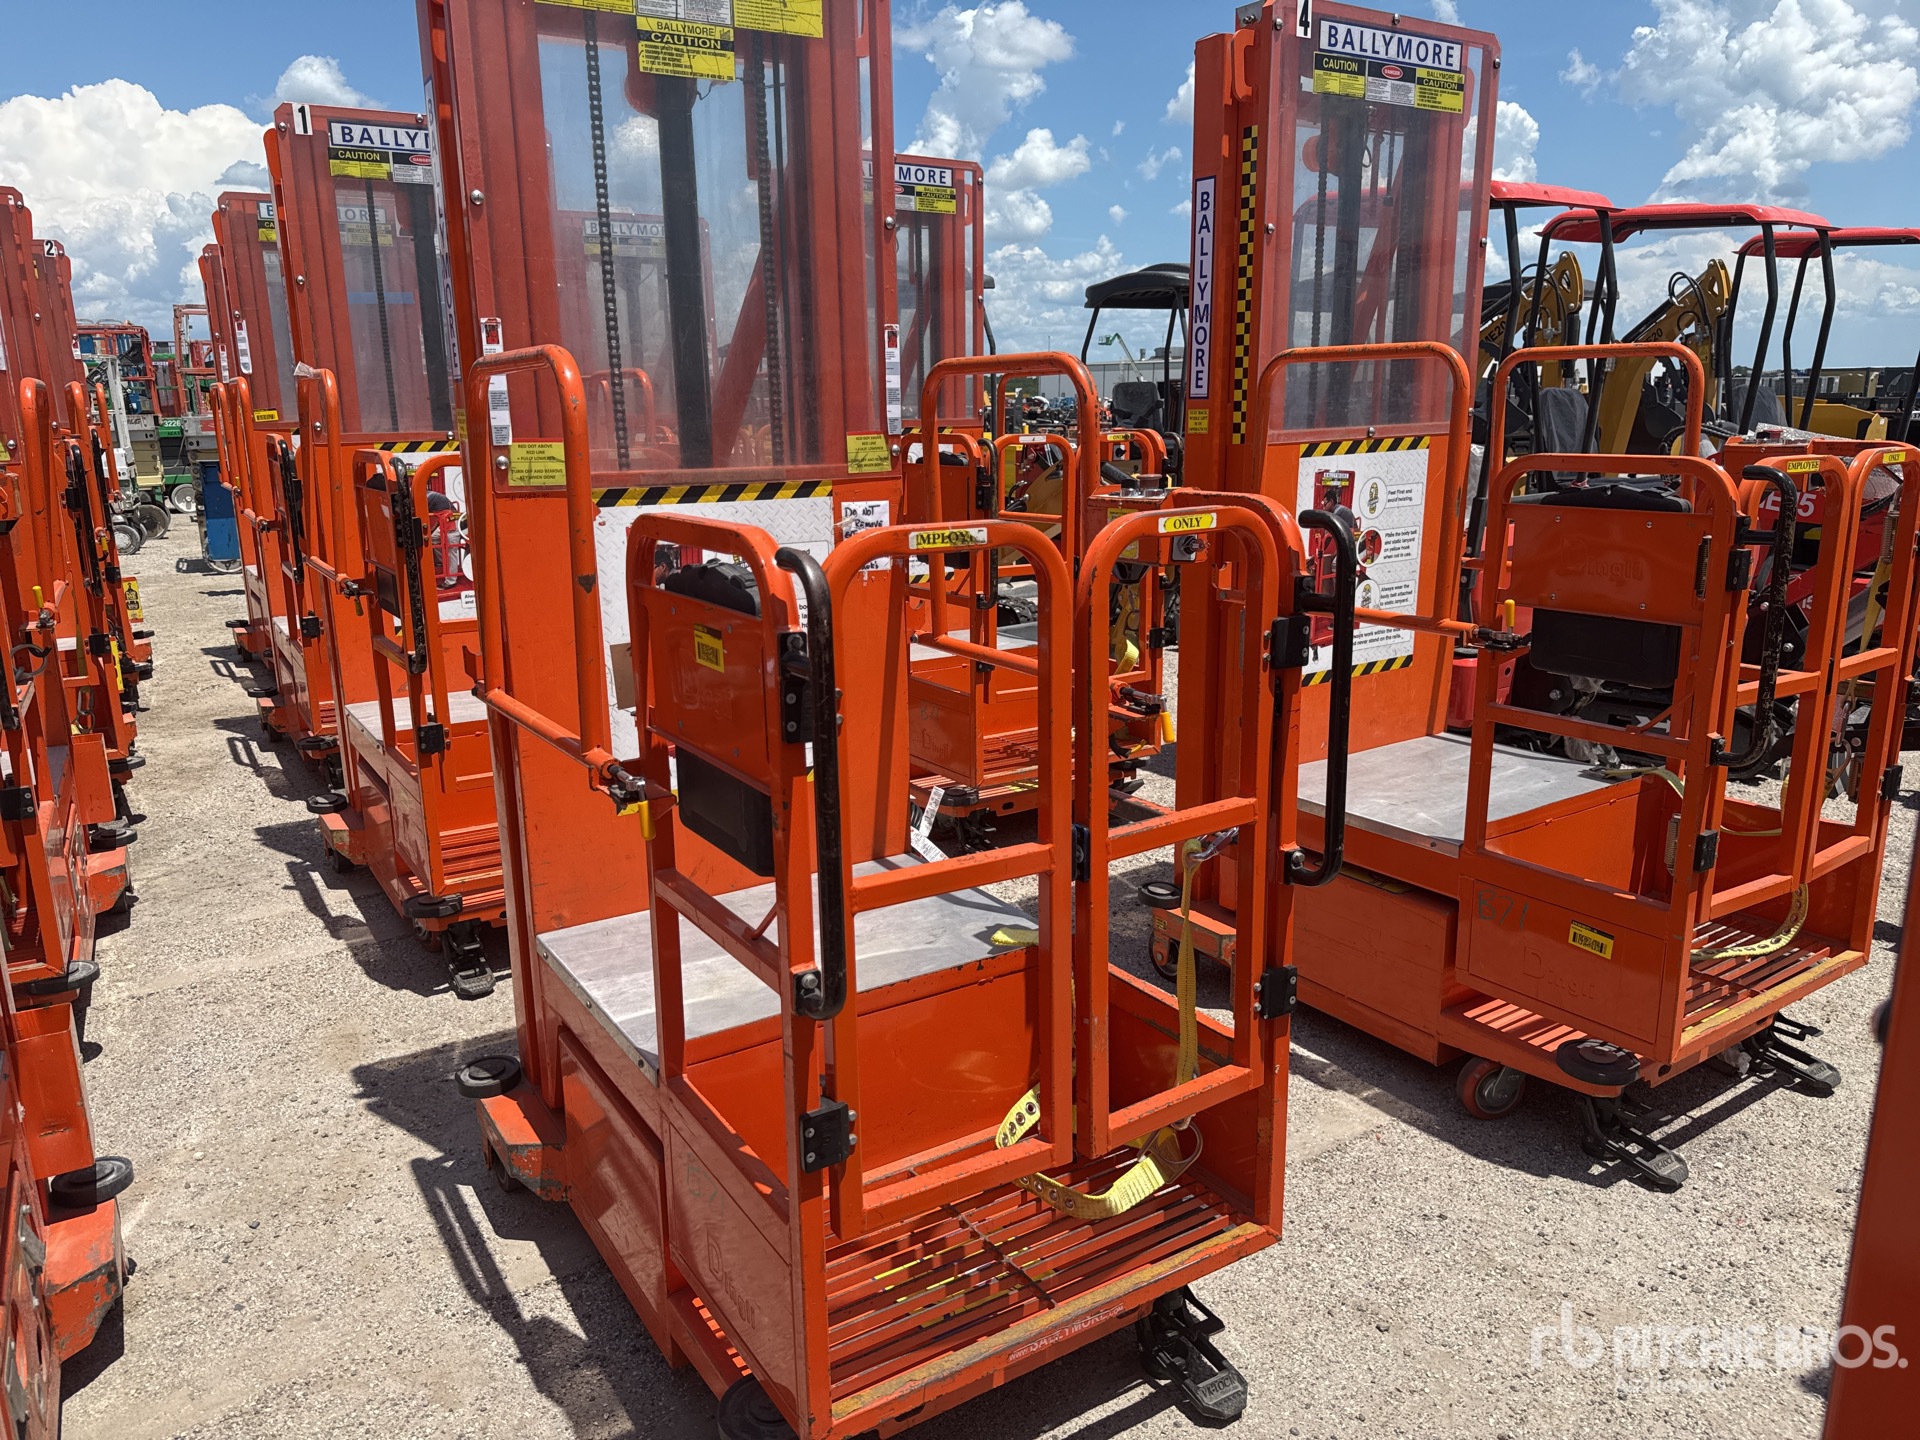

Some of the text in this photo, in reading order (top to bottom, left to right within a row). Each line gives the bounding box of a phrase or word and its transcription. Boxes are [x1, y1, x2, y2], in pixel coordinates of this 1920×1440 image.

[1299, 0, 1310, 36] 4
[657, 21, 715, 37] BALLYMORE
[651, 33, 721, 49] CAUTION
[1327, 25, 1455, 67] BALLYMORE
[1323, 57, 1358, 72] CAUTION
[1426, 71, 1456, 80] BALLYMORE
[1423, 78, 1458, 90] CAUTION
[298, 105, 308, 134] 1
[338, 150, 380, 160] CAUTION
[898, 166, 946, 184] MORE
[590, 222, 665, 236] BLLYMO
[45, 240, 55, 256] 2
[1194, 191, 1211, 389] BALLYMORE
[1888, 453, 1900, 461] ONLY
[1787, 460, 1819, 471] EMPLOYEE
[1173, 516, 1203, 530] ONLY
